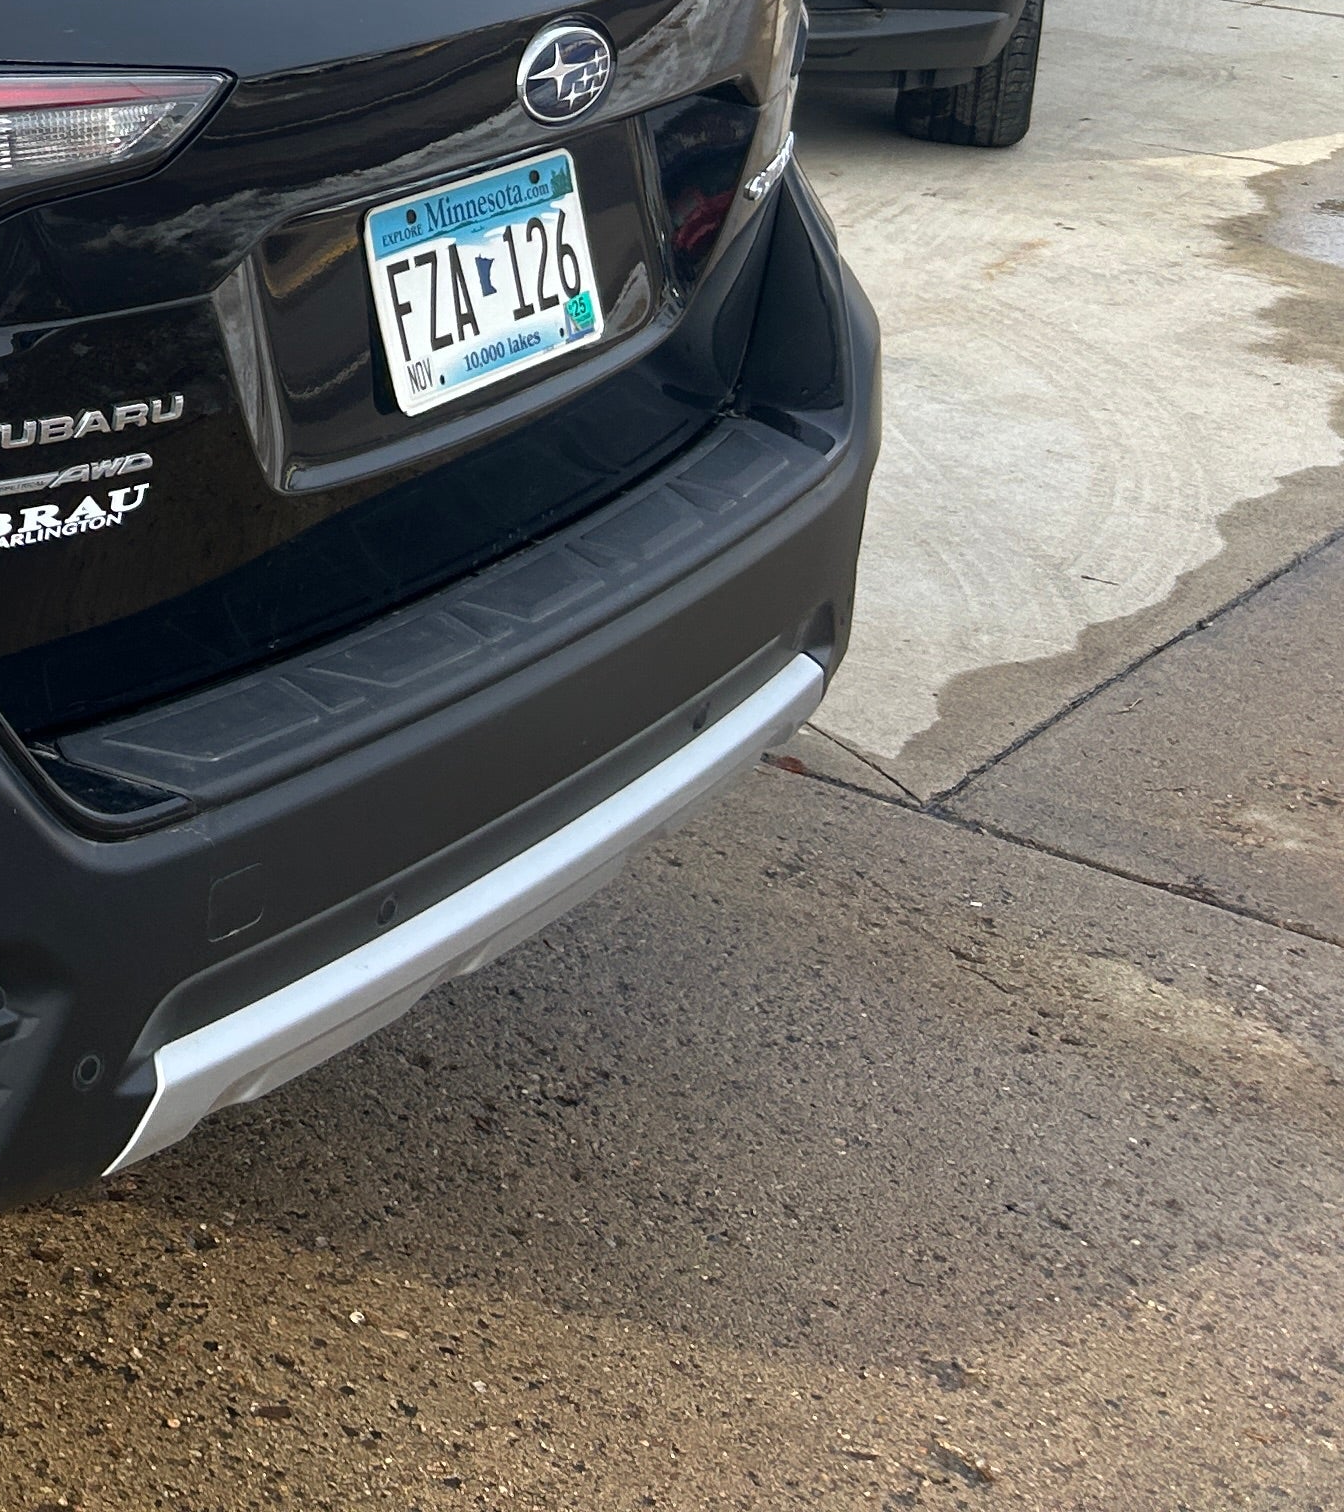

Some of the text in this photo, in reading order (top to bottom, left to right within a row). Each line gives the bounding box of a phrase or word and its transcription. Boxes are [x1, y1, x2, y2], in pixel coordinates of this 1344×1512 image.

[381, 182, 550, 247] EXPLORE Minnesota.com
[386, 209, 581, 362] FZA 126
[573, 296, 587, 317] 25
[463, 330, 541, 372] 10,000 lakes
[406, 357, 434, 394] NOV
[50, 452, 153, 488] AWD
